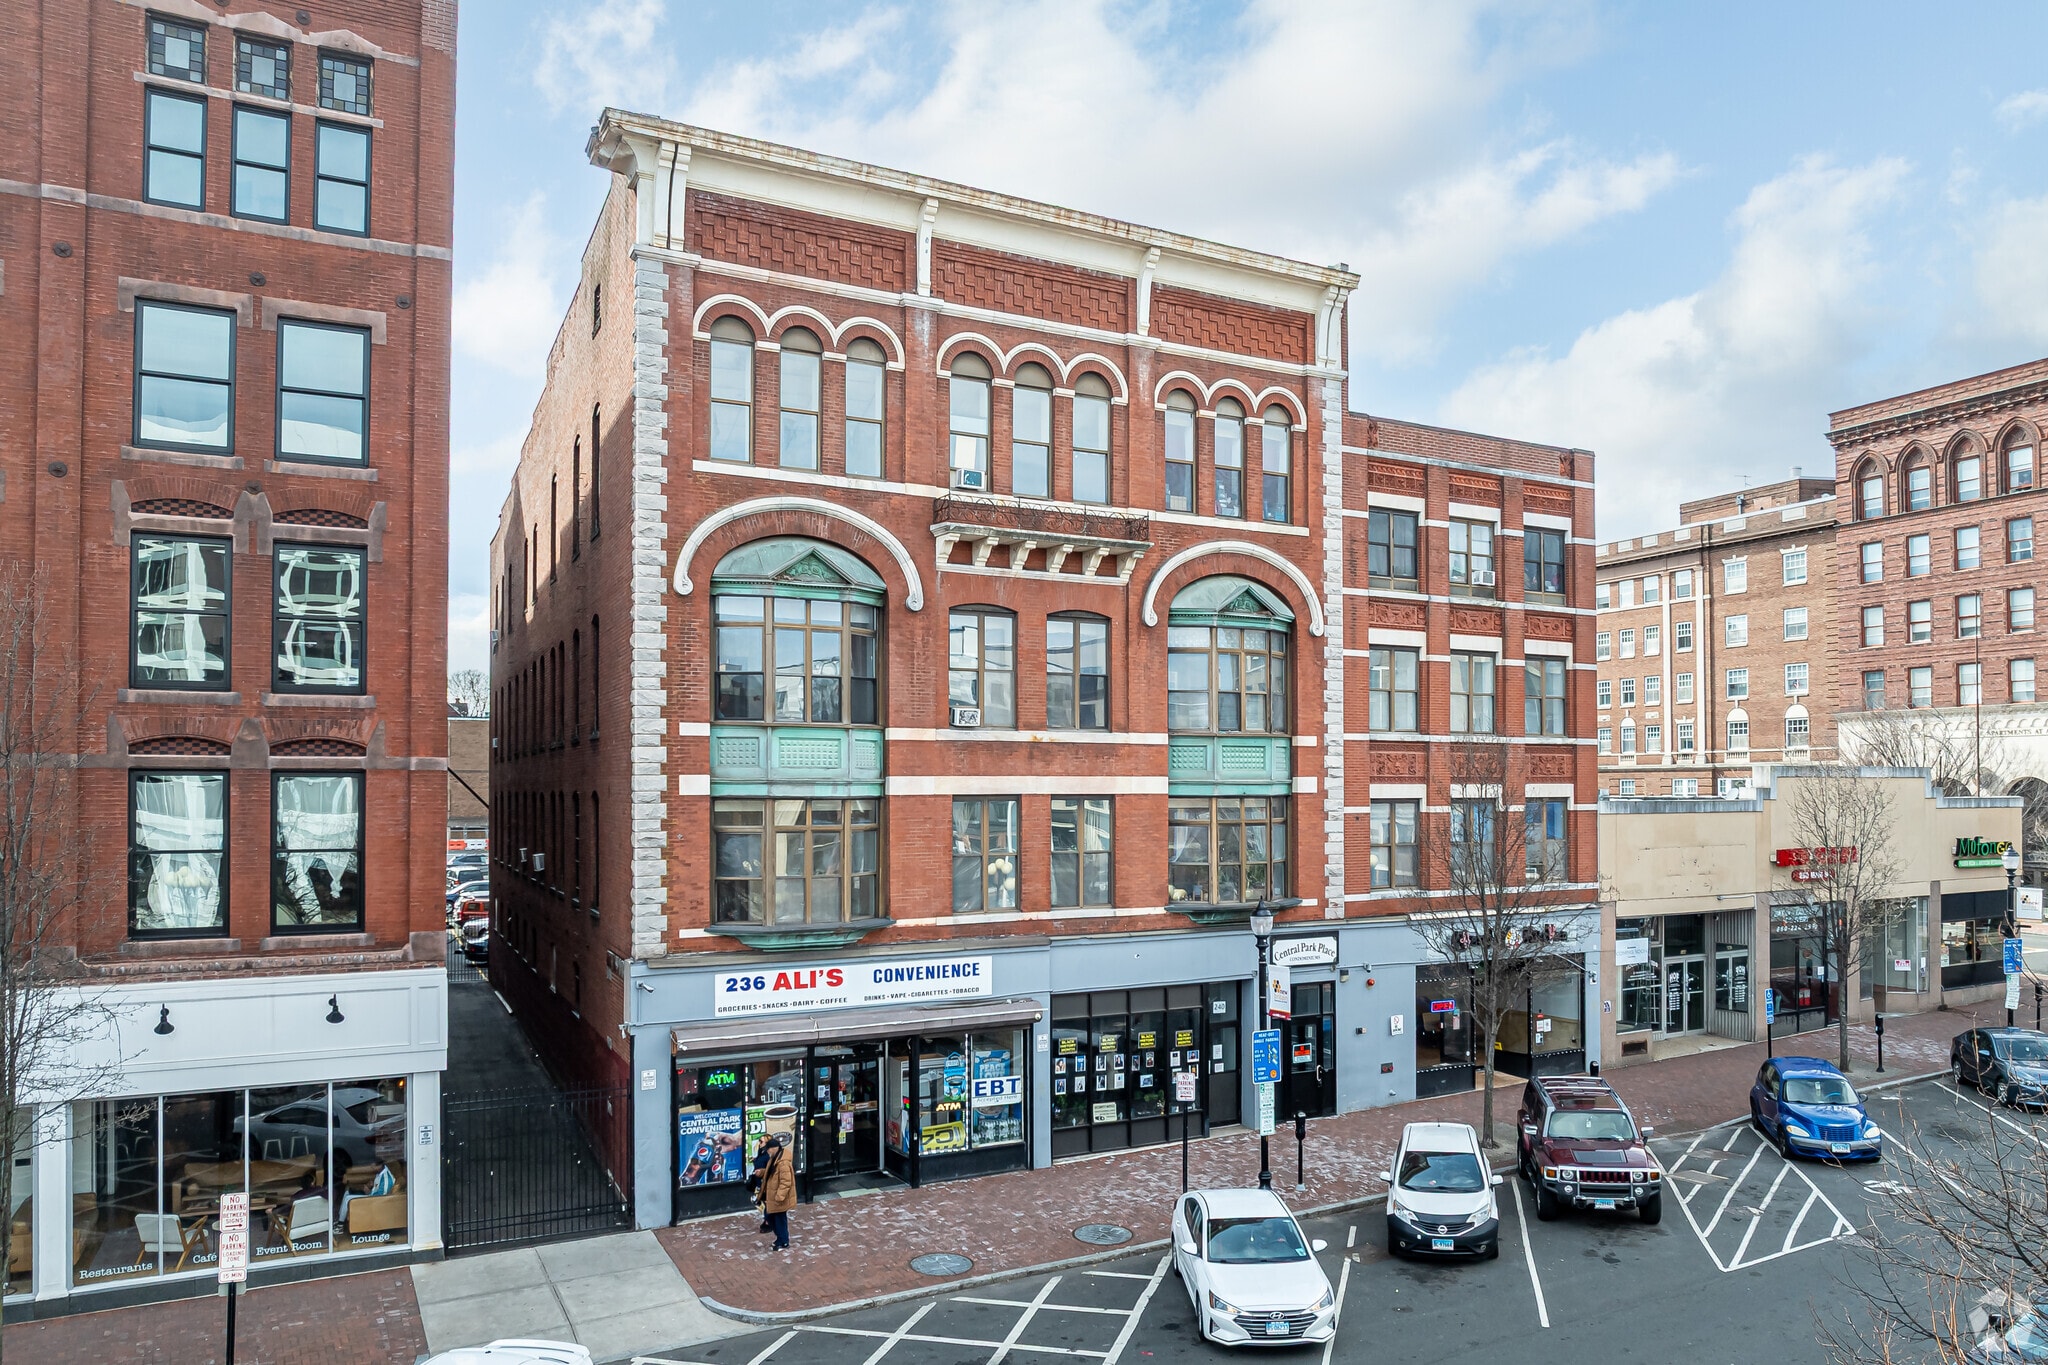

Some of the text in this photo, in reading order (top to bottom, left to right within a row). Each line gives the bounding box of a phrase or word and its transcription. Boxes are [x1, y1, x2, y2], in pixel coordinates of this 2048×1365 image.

[1274, 942, 1336, 962] Central Park Place
[873, 962, 980, 983] CONVENIENCE
[726, 968, 844, 993] 236 ALI'S
[911, 989, 948, 997] CIGARETTES
[717, 996, 847, 1013] GROCERIES SNACKS DAIRY COFFEE
[1434, 1002, 1453, 1010] OPEN
[979, 1063, 1006, 1074] PEACE
[706, 1072, 735, 1086] ATM
[975, 1078, 1021, 1097] EBT
[936, 1102, 961, 1112] ATM
[680, 1114, 741, 1128] CENTRAL PARK
[693, 1112, 720, 1120] WELCOME
[680, 1122, 741, 1135] CONVENIENCE
[230, 1196, 240, 1204] NO
[228, 1234, 240, 1242] NO
[351, 1233, 390, 1244] Lounge
[256, 1240, 322, 1256] Event Room
[192, 1252, 217, 1264] Café
[79, 1262, 153, 1279] Restaurants
